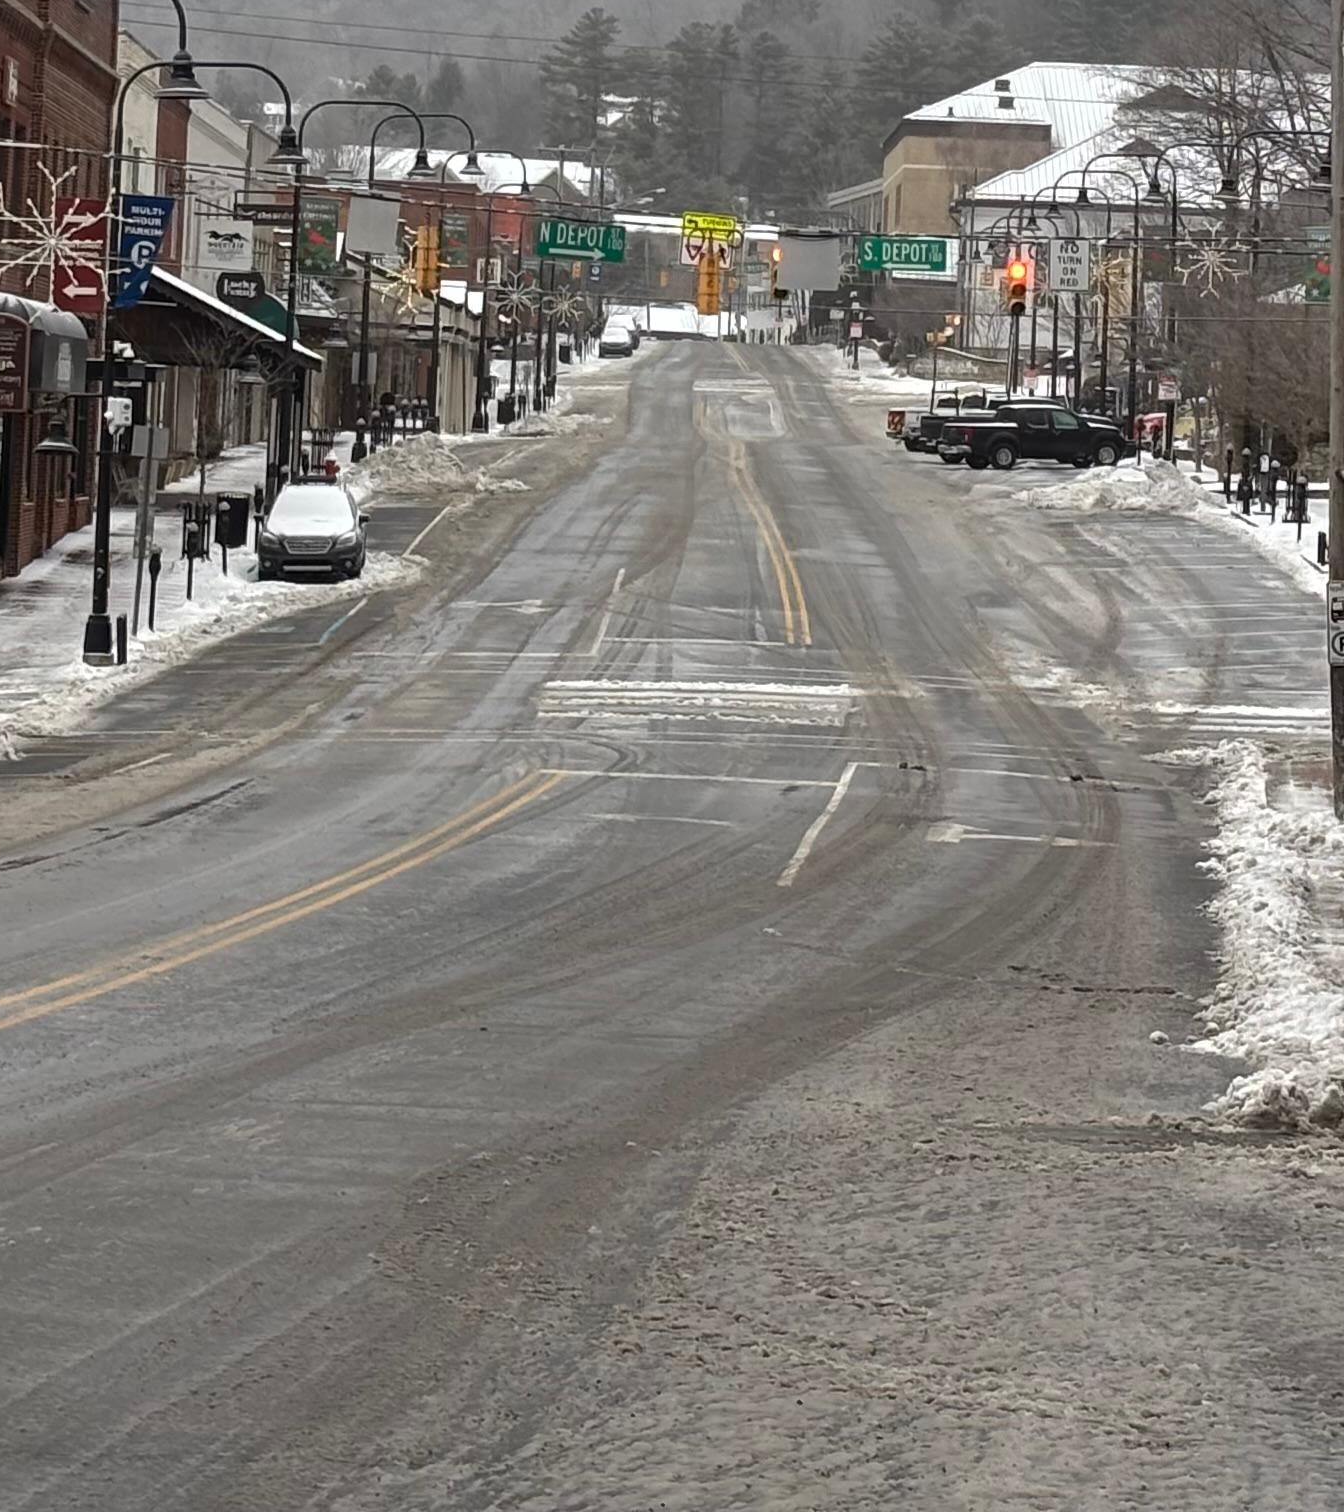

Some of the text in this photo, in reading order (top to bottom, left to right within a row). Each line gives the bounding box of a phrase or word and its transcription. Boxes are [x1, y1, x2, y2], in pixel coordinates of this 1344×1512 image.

[540, 221, 606, 247] N DEPOT
[863, 241, 928, 263] S. DEPOT
[1060, 242, 1080, 254] NO
[1057, 255, 1082, 265] TURN
[1062, 267, 1077, 276] ON
[1060, 277, 1079, 287] RED
